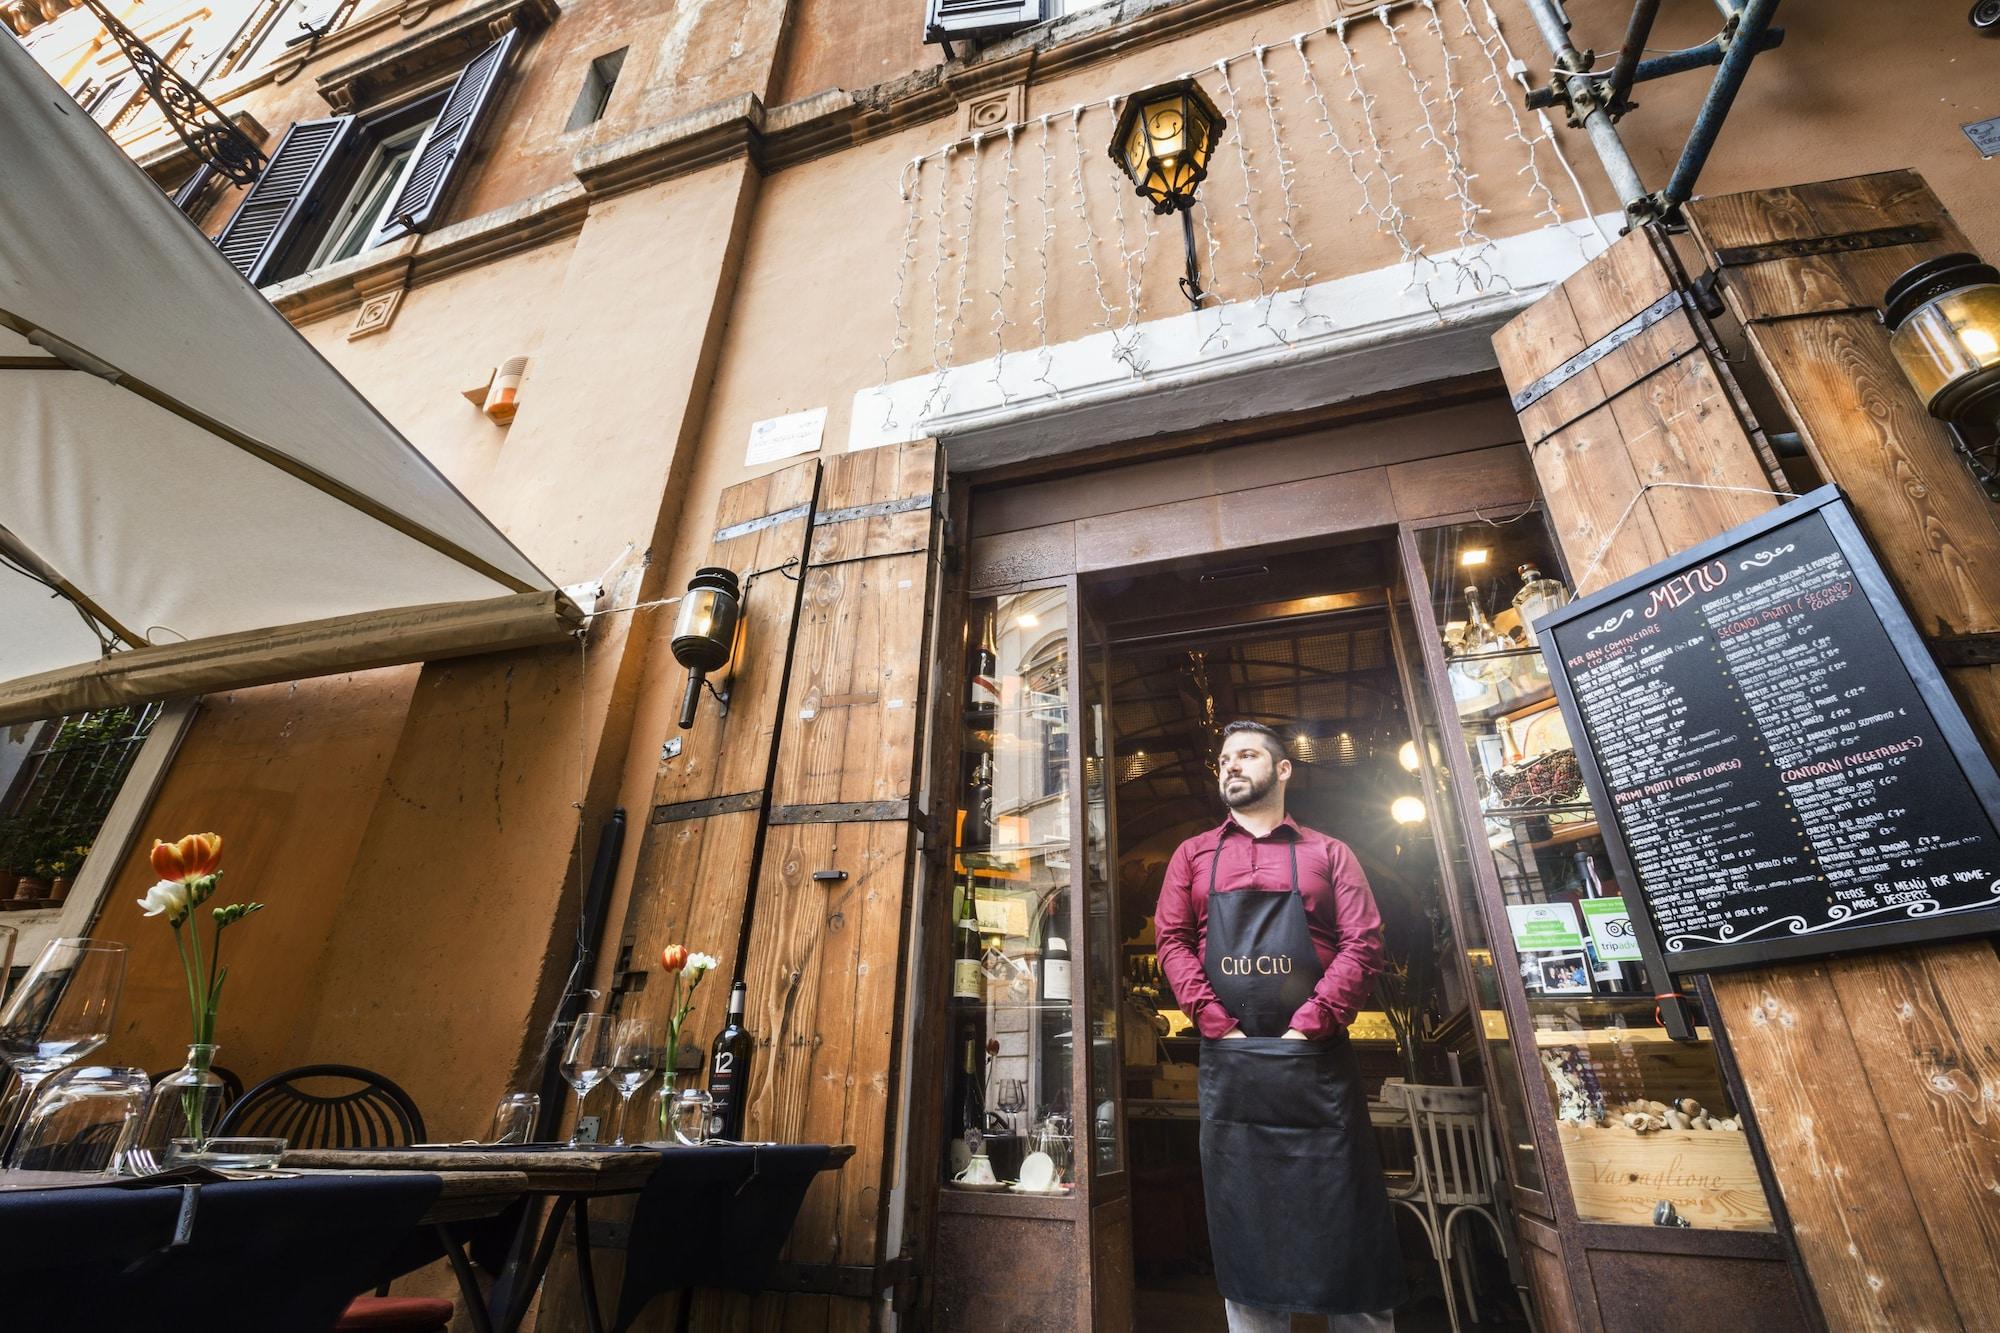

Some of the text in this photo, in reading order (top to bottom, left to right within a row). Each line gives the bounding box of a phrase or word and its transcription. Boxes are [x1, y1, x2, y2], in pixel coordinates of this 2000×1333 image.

[1717, 616, 1760, 639] SECONDI
[1760, 603, 1794, 621] PIATTI
[1567, 655, 1585, 668] PER
[1584, 647, 1603, 660] BEN
[1603, 623, 1661, 653] COMINCIARE
[1773, 751, 1805, 767] COSTATA
[1780, 735, 1923, 783] CONTORNI (VEGETABLES)
[1614, 789, 1643, 805] PRIMI
[1643, 779, 1674, 795] PIATTI
[1675, 771, 1702, 787] (FIRST
[1702, 757, 1742, 778] COURSE)
[1831, 800, 1853, 813] MISTA
[1847, 830, 1870, 843] FORNO
[1834, 886, 1867, 901] PLEASE
[1873, 882, 1892, 894] SEE
[1929, 874, 1951, 888] FOR
[1851, 889, 1931, 911] MADE DESSERTS
[714, 1051, 734, 1074] 12
